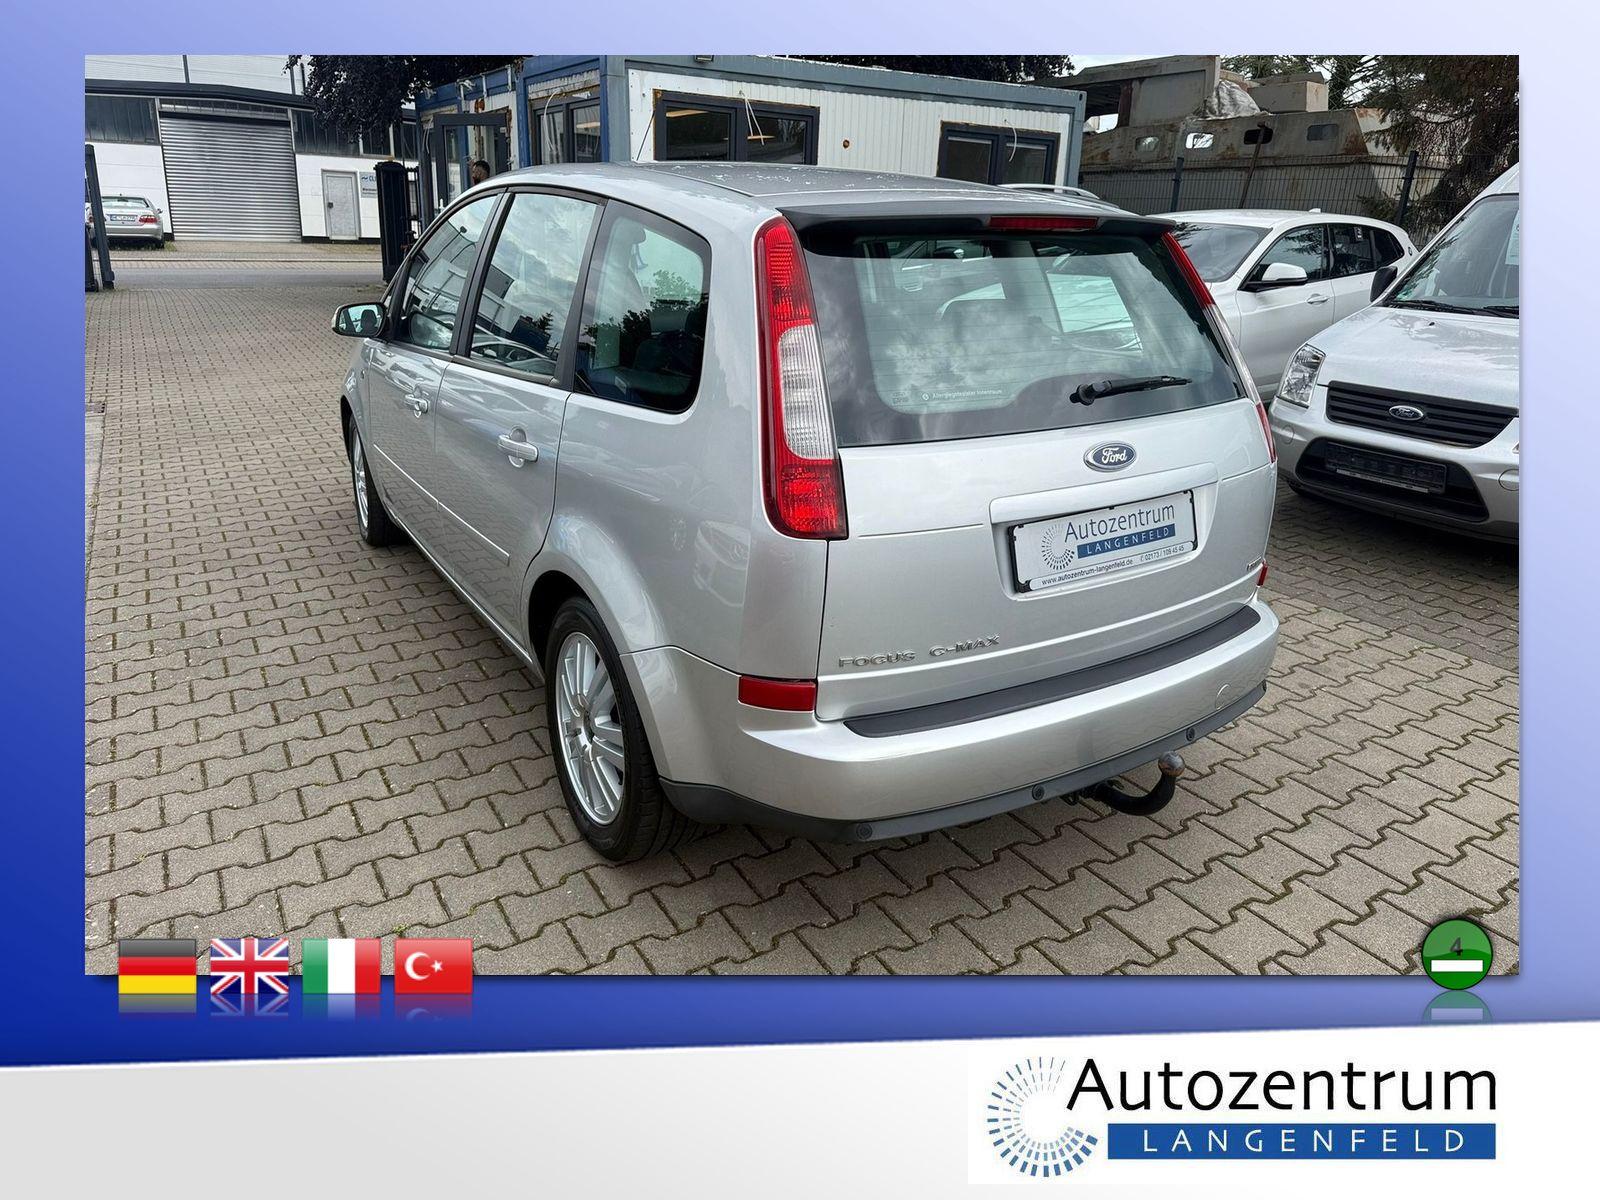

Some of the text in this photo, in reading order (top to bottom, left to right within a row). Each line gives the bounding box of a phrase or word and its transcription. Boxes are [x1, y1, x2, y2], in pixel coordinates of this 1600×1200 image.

[1101, 447, 1128, 464] Ford
[1064, 504, 1175, 542] Autozentrum
[1086, 527, 1169, 554] LANGENFELD
[1041, 559, 1133, 585] www.autozentrum-langenfeld.de
[1144, 551, 1161, 562] 02173
[838, 633, 1000, 668] FOCUS C-MAX
